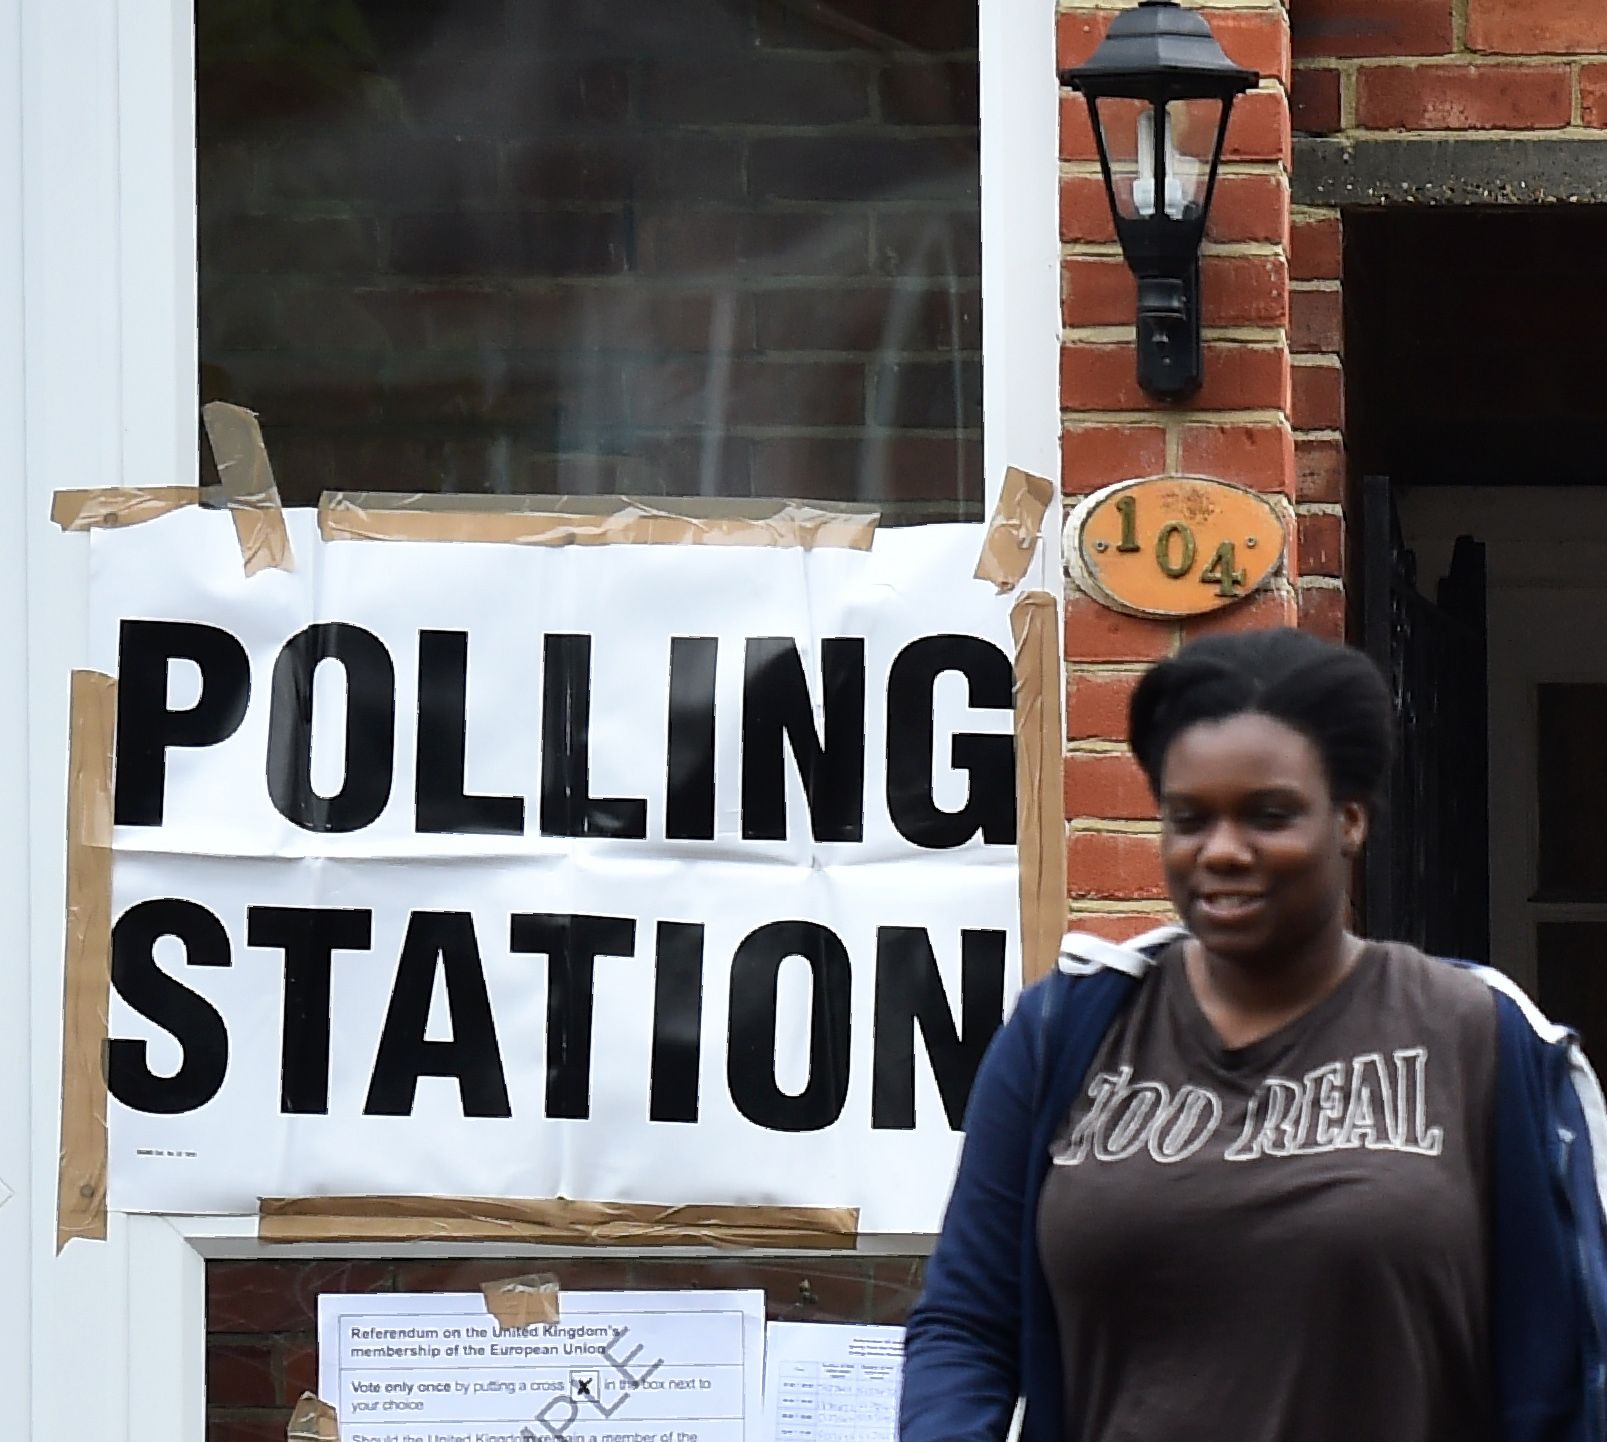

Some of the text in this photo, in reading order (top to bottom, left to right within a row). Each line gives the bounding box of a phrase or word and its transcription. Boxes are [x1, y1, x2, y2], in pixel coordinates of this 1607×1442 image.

[1115, 495, 1246, 596] 104
[112, 618, 1016, 849] POLLING
[106, 897, 1007, 1131] STATION
[1224, 1046, 1443, 1161] REAL
[351, 1326, 439, 1339] Referendum
[466, 1327, 487, 1338] the
[492, 1324, 539, 1338] United
[351, 1345, 440, 1358] membership
[463, 1344, 485, 1356] the
[490, 1344, 558, 1358] European
[352, 1381, 380, 1393] Vote
[385, 1381, 414, 1396] only
[418, 1383, 450, 1393] once
[474, 1380, 515, 1396] putting
[530, 1382, 564, 1391] cross
[643, 1379, 664, 1389] box
[669, 1379, 696, 1389] next
[352, 1400, 424, 1414] your choice
[677, 1433, 697, 1442] the
